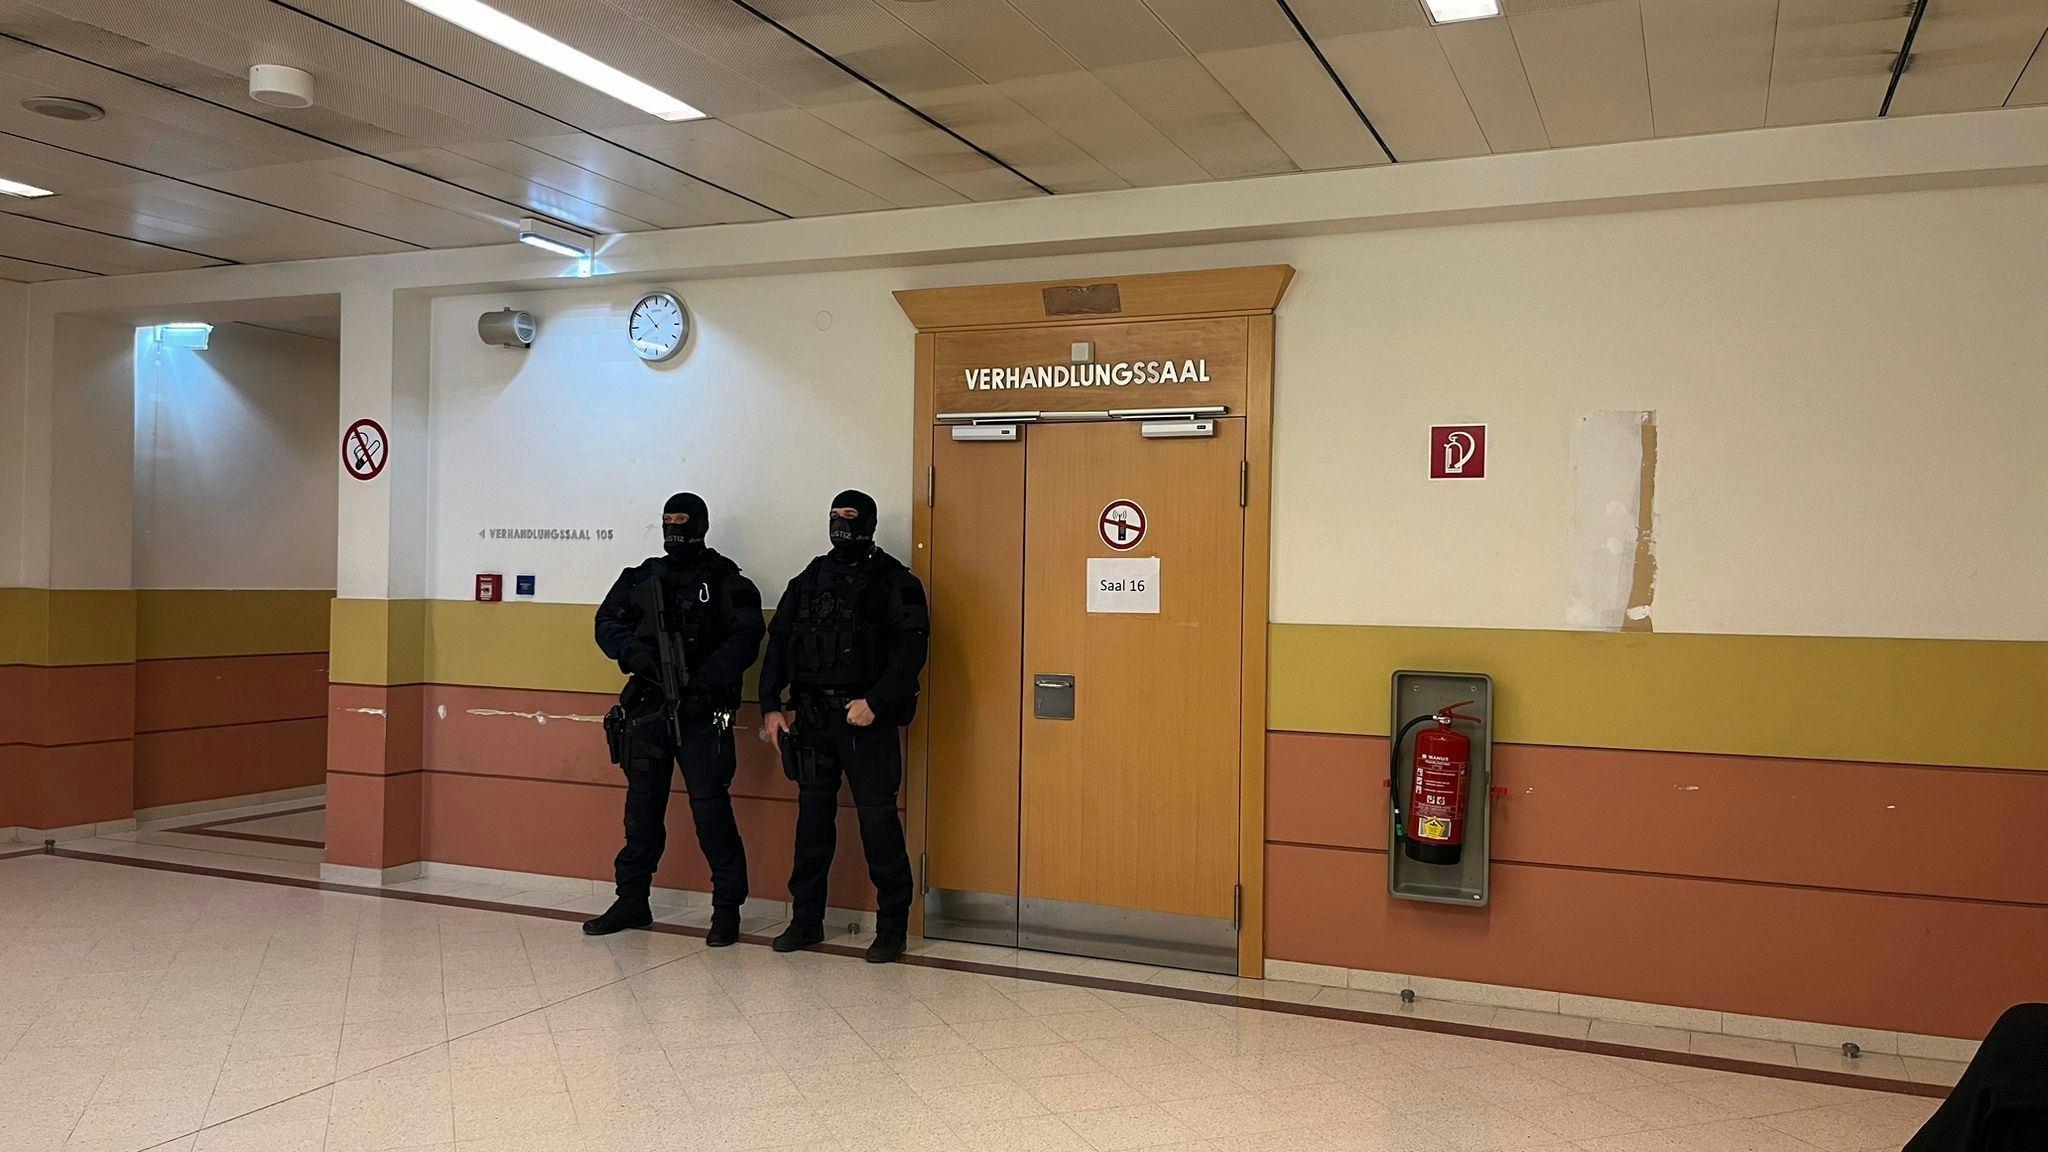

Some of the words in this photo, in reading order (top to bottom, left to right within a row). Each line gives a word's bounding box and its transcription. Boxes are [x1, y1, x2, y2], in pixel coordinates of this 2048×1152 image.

[964, 359, 1211, 390] VERHANDLUNGSSAAL
[489, 528, 590, 540] VERHANDLUNGSSAAL
[596, 529, 614, 540] 105
[1100, 579, 1125, 592] Saal
[1130, 579, 1145, 592] 16
